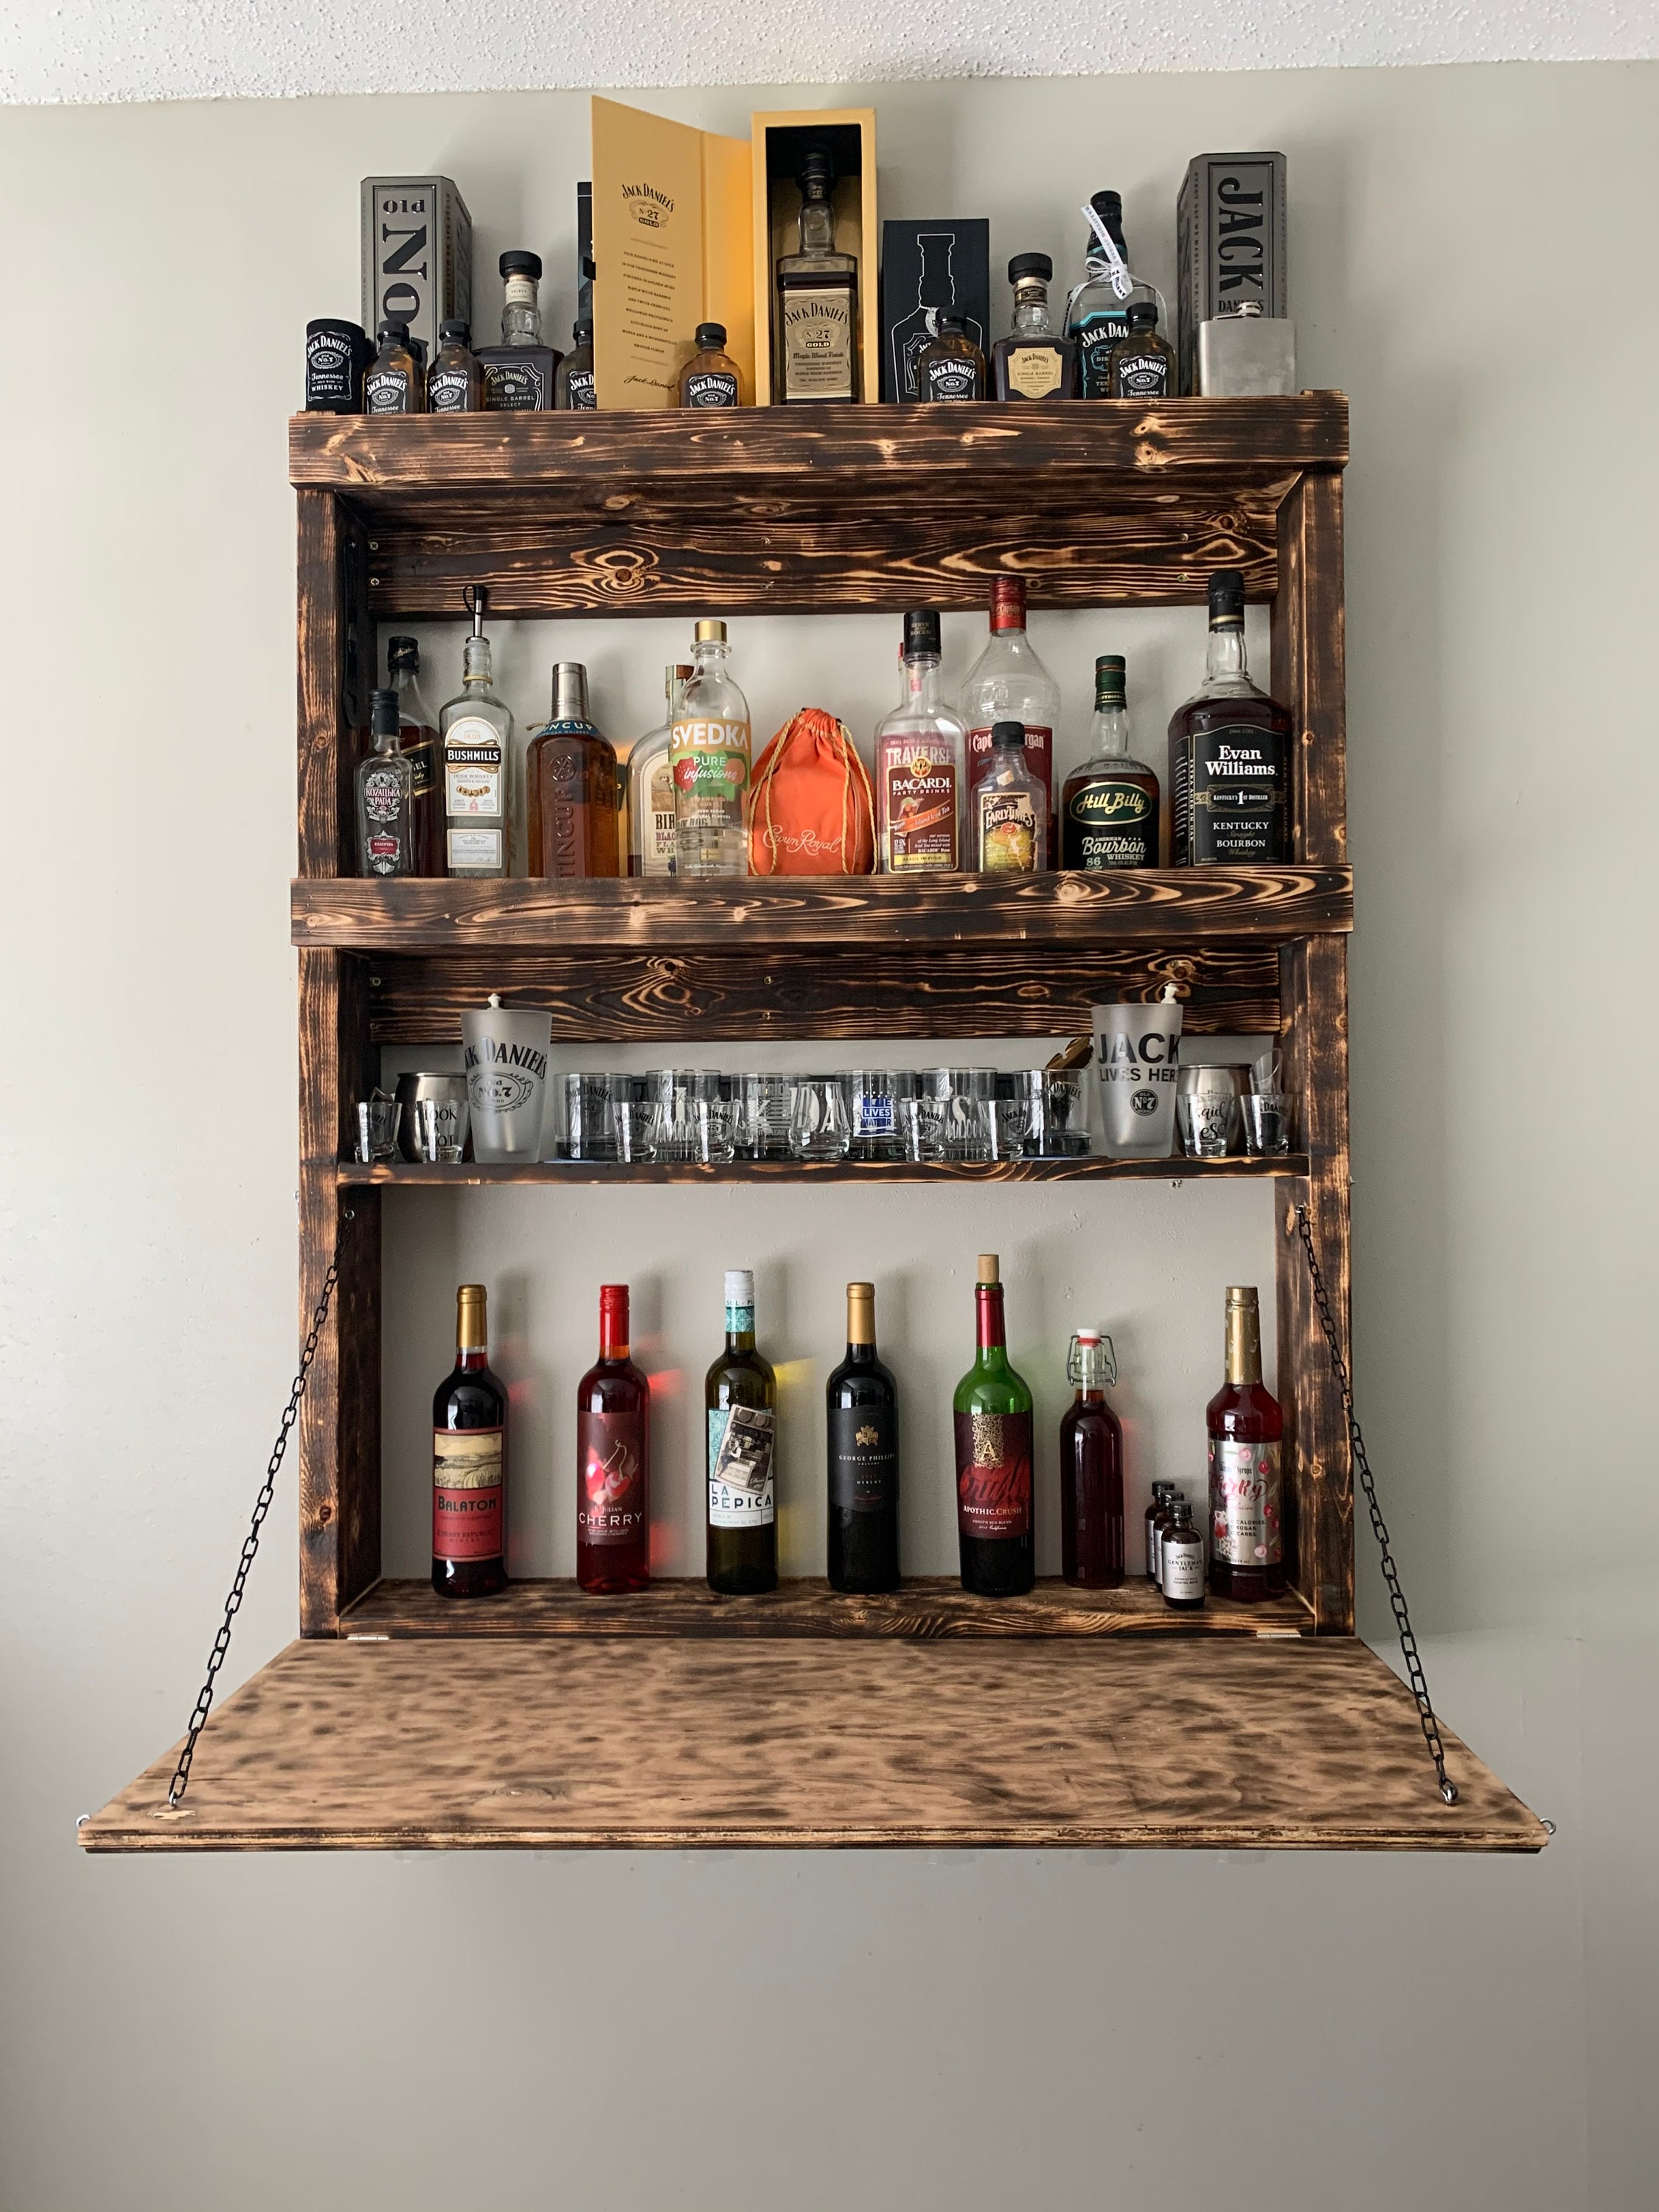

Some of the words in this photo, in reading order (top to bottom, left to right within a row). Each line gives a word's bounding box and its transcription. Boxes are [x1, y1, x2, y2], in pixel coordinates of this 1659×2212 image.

[622, 184, 643, 199] JACK
[1218, 177, 1263, 293] JACK
[785, 307, 810, 327] JACK
[811, 302, 849, 324] DANIEL'S
[816, 330, 830, 339] 27
[1081, 327, 1107, 348] JACK
[320, 335, 352, 358] DANIEL'S
[929, 365, 947, 380] JACK
[947, 361, 976, 380] DANIEL'S
[1120, 364, 1138, 378] JACK
[1138, 358, 1167, 376] DANIEL'S
[311, 373, 344, 381] Tennessee
[366, 378, 380, 395] JACK
[380, 375, 407, 392] DANIEL'S
[491, 374, 505, 386] JACK
[505, 371, 529, 386] DANIEL'S
[570, 376, 589, 390] JACK
[430, 378, 443, 396] JACK
[442, 375, 469, 390] DANIEL'S
[689, 381, 706, 396] JACK
[707, 377, 736, 396] DANIEL'S
[672, 723, 748, 749] SVEDKA
[973, 733, 992, 753] Capt
[1025, 734, 1044, 749] rgan
[448, 749, 499, 761] BUSHMILLS
[1218, 745, 1262, 759] Evan
[693, 757, 726, 767] PURE
[1205, 761, 1275, 776] Williams
[684, 765, 737, 783] infusions
[893, 778, 950, 791] BACARDI
[1077, 793, 1109, 814] Hill
[1105, 793, 1145, 815] Billy
[915, 815, 930, 825] Island
[931, 810, 941, 820] Iced
[942, 806, 950, 815] Tea
[985, 808, 1006, 829] EARLY
[1189, 813, 1194, 821] IN
[1213, 822, 1270, 830] KENTUCKY
[787, 830, 842, 856] Royal
[894, 838, 906, 846] 12.5%
[1082, 837, 1147, 855] Bourbon
[1086, 857, 1101, 866] 86
[1099, 1033, 1180, 1064] JACK
[1100, 1068, 1141, 1082] LIVES
[1149, 1068, 1178, 1082] HER
[978, 1439, 998, 1461] A
[712, 1484, 728, 1496] LA
[438, 1495, 496, 1512] BALATON
[602, 1505, 622, 1514] JULIAN
[712, 1495, 772, 1509] PEPICA
[963, 1505, 995, 1515] APOTHIC
[996, 1507, 1022, 1516] CRUSH
[579, 1512, 642, 1526] CHERRY
